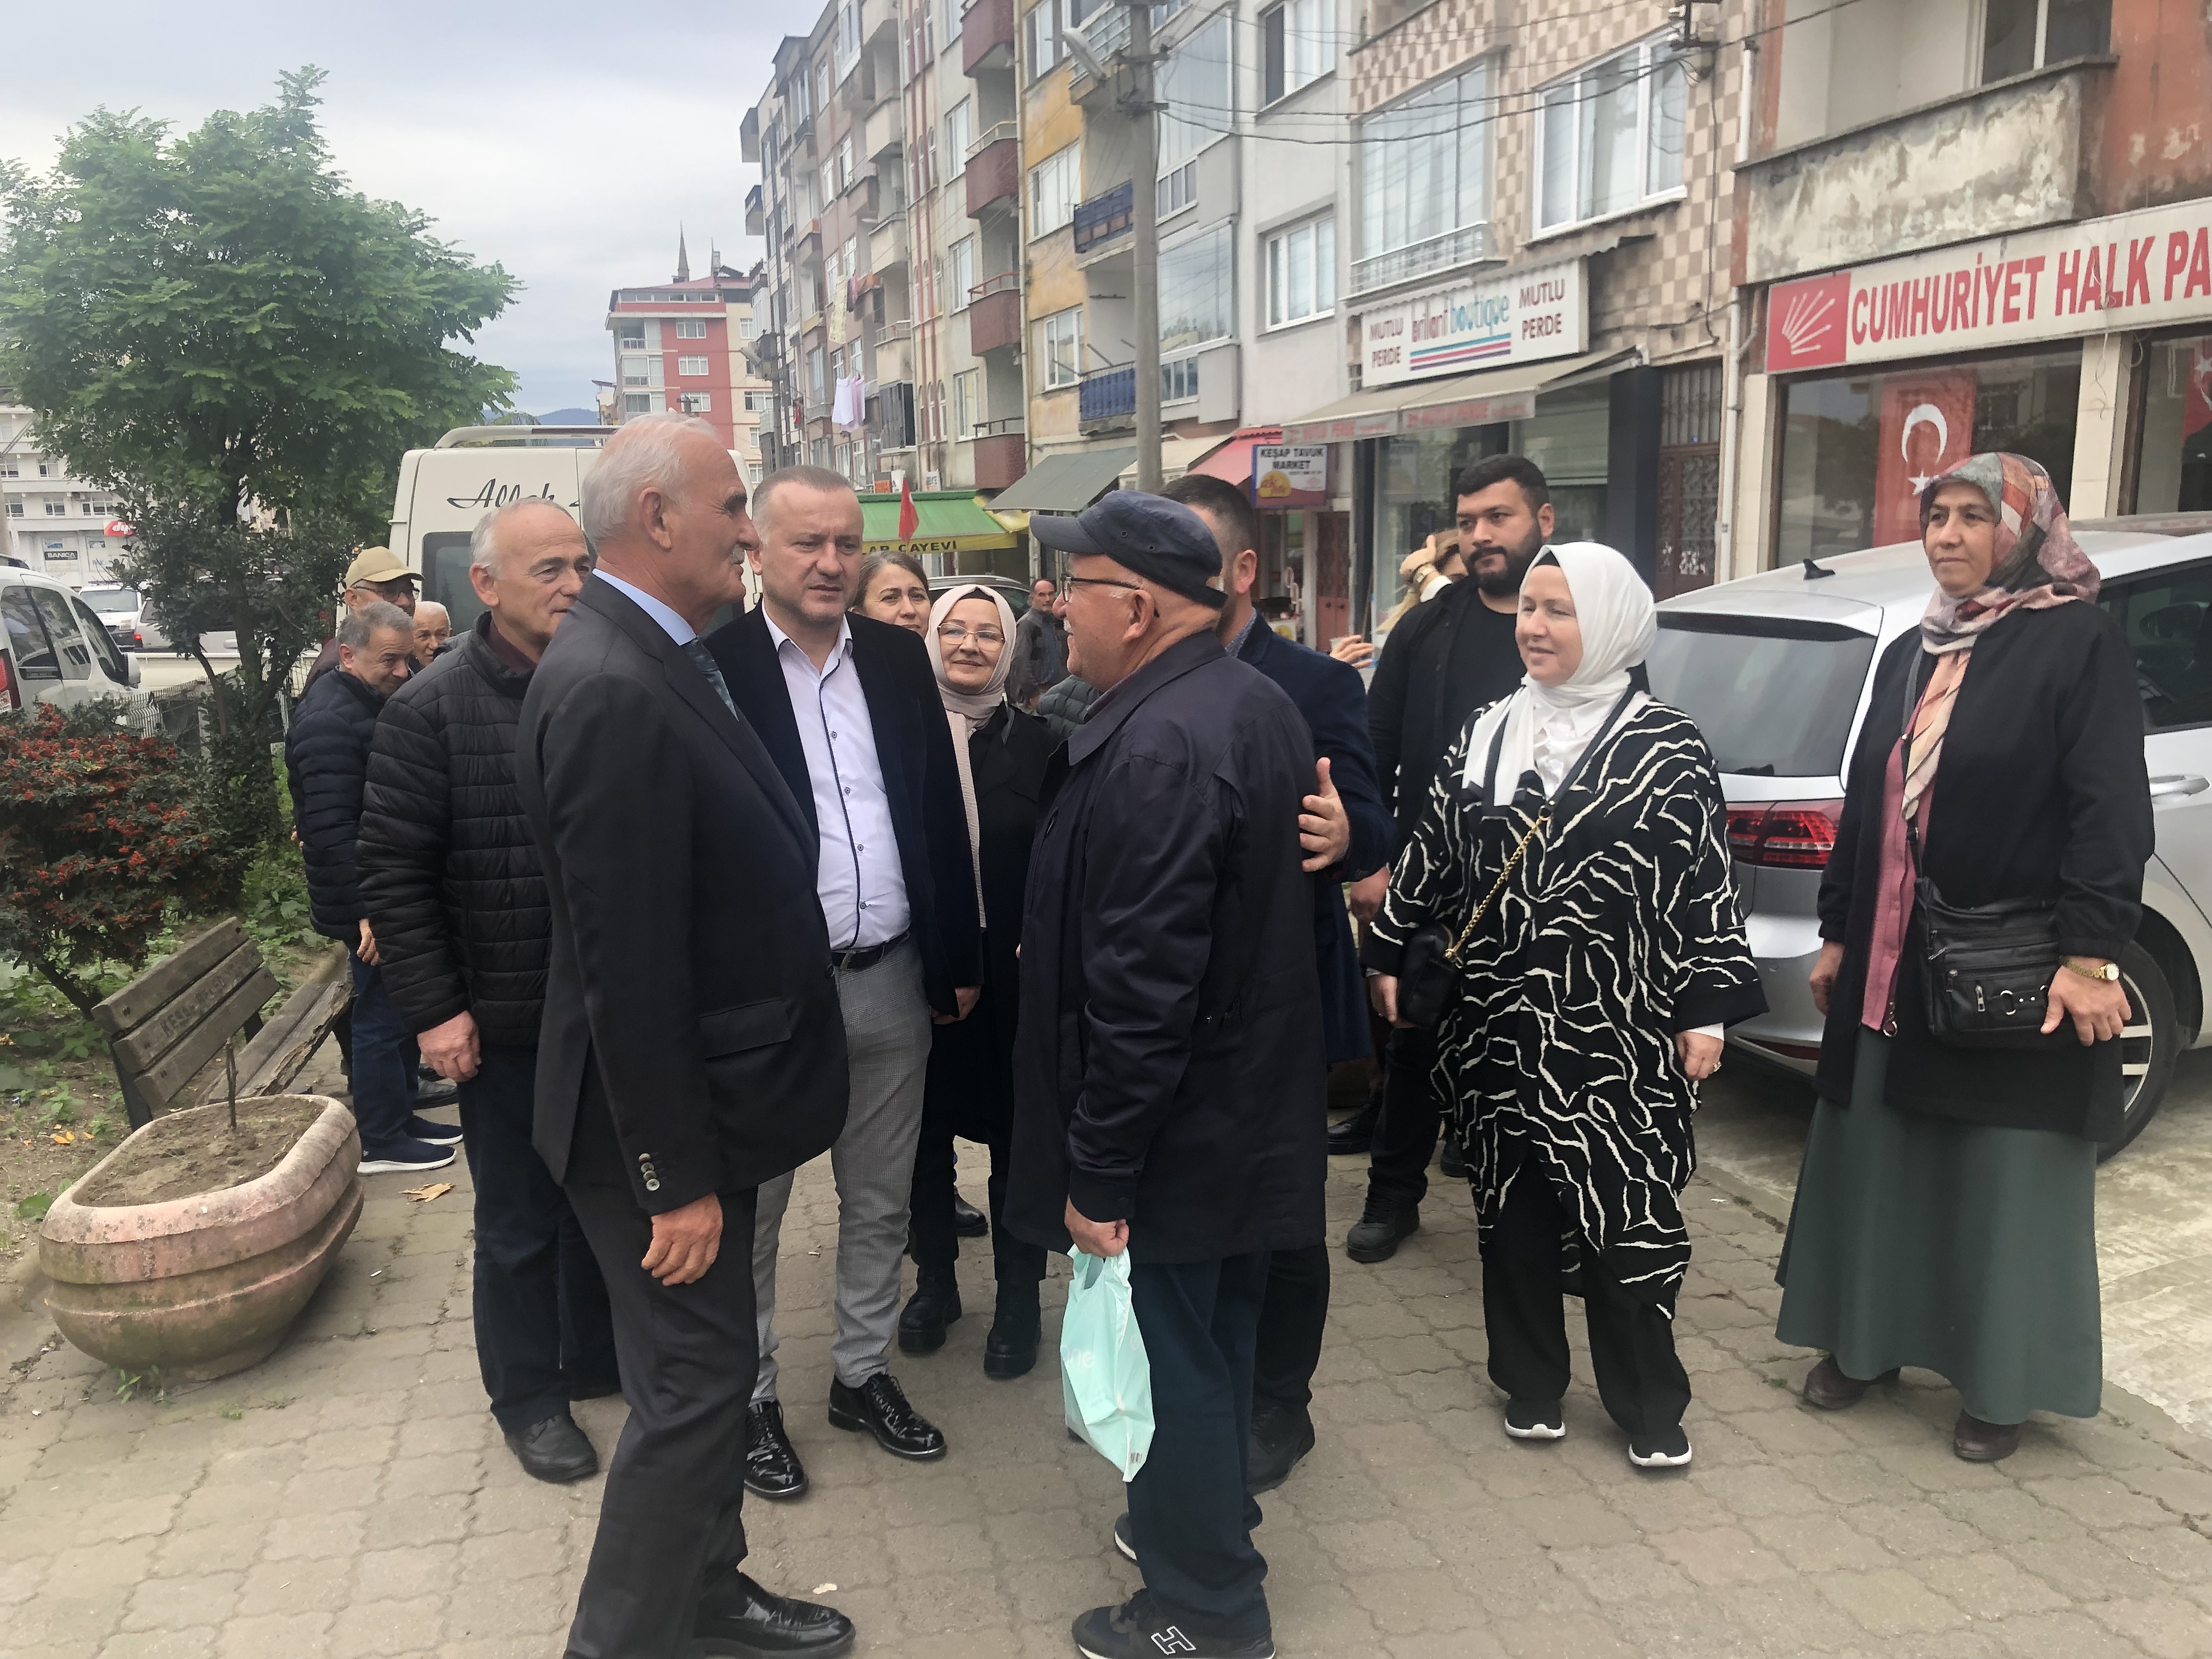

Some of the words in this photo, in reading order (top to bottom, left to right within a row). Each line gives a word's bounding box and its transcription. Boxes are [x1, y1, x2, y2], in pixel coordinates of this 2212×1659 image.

[1518, 278, 1566, 309] MUTLU
[1852, 251, 2046, 345] CUMHURİYET
[2055, 235, 2156, 317] HALK
[1449, 294, 1510, 336] boutique
[1521, 313, 1563, 340] PERDE
[1369, 317, 1404, 341] MUTLU
[1371, 346, 1402, 369] PERDE
[1272, 460, 1311, 470] MARKET
[1294, 448, 1324, 457] TAVUK
[447, 478, 555, 509] Allh
